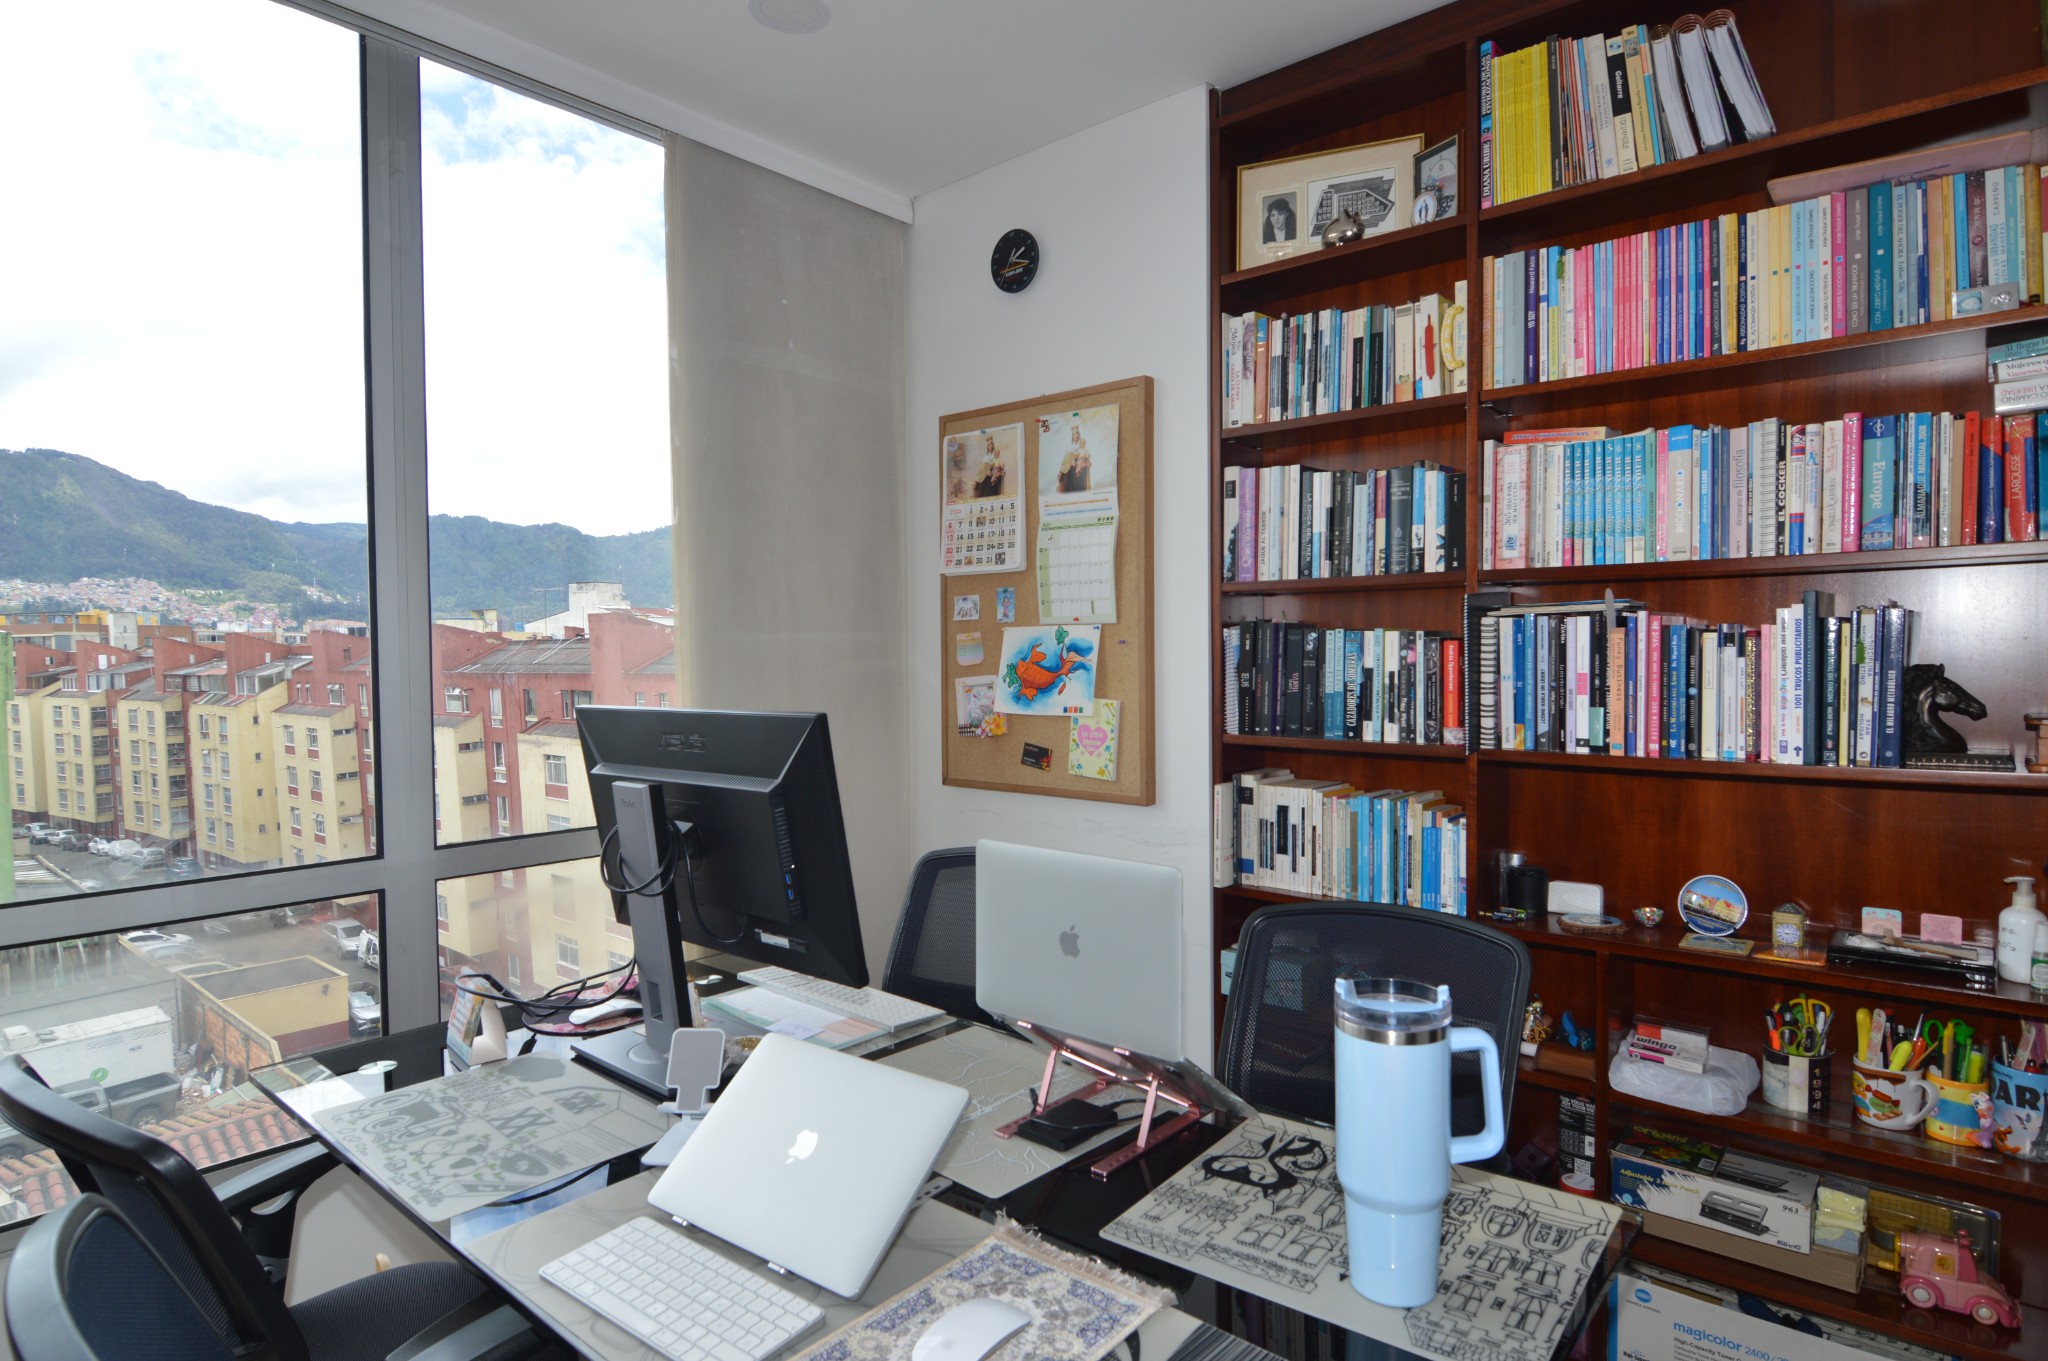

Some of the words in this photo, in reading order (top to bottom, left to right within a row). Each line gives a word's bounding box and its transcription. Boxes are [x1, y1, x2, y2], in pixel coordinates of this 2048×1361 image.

[1615, 70, 1624, 99] Guitarra
[1482, 141, 1491, 167] URIBE
[1482, 168, 1491, 197] DIANA
[1991, 181, 2000, 216] CARREÑO
[1896, 200, 1904, 222] PODER
[1897, 222, 1905, 236] DEL
[1999, 222, 2007, 255] MANERAS
[1897, 236, 1905, 259] AHORA
[1897, 261, 1906, 280] Eckhart
[1898, 280, 1906, 293] Tolle
[1527, 310, 1535, 321] SOY
[1230, 327, 1239, 356] Moyes
[2006, 360, 2041, 370] Mujeres
[2006, 367, 2043, 377] Vanessa
[2000, 393, 2038, 403] CAMINO
[2001, 385, 2037, 396] LIBERTAD
[1919, 425, 1927, 440] 2008
[1732, 449, 1746, 489] filosofía
[1917, 441, 1927, 474] MUNDIAL
[1574, 460, 1582, 495] SABER
[1595, 456, 1603, 491] SABER
[1615, 457, 1623, 491] SABER
[1778, 460, 1786, 507] COCKER
[1869, 460, 1886, 509] Europe
[2010, 454, 2021, 499] LAROUSSE
[1307, 493, 1312, 502] LA
[1675, 469, 1685, 533] DICCIONARIO
[1828, 477, 1837, 501] AHERN
[1916, 474, 1926, 519] ALMANAQUE
[988, 517, 995, 525] 10
[1735, 497, 1743, 527] diccionario
[1778, 509, 1785, 522] EL
[986, 543, 994, 551] 24
[1261, 536, 1266, 544] AL
[1651, 621, 1659, 630] 48
[1615, 637, 1624, 660] Funky
[1794, 617, 1802, 665] PUBLICITARIOS
[1346, 652, 1357, 681] SOMBRAS
[1781, 646, 1789, 677] customer's
[1866, 639, 1874, 677] DISCIPLINA
[1346, 681, 1357, 690] DE
[1616, 664, 1624, 702] Business
[1670, 671, 1678, 686] AMOR
[1794, 666, 1802, 691] TRUCOS
[1886, 670, 1896, 702] METABÓLICO
[1780, 677, 1789, 710] imagination
[1794, 693, 1802, 709] 1001
[1345, 691, 1357, 727] CAZADORES
[1886, 703, 1895, 726] MILAGRO
[1670, 724, 1677, 732] LA
[659, 733, 706, 752] ASUS
[1636, 1036, 1677, 1050] wingo
[1620, 1168, 1654, 1182] Adjustable
[1679, 1183, 1700, 1195] Punch
[1782, 1204, 1799, 1214] 963
[1642, 1303, 1662, 1314] MINOLTA
[1673, 1321, 1743, 1352] magicolor
[1673, 1336, 1716, 1356] High-Capacity
[1717, 1349, 1736, 1360] Toner
